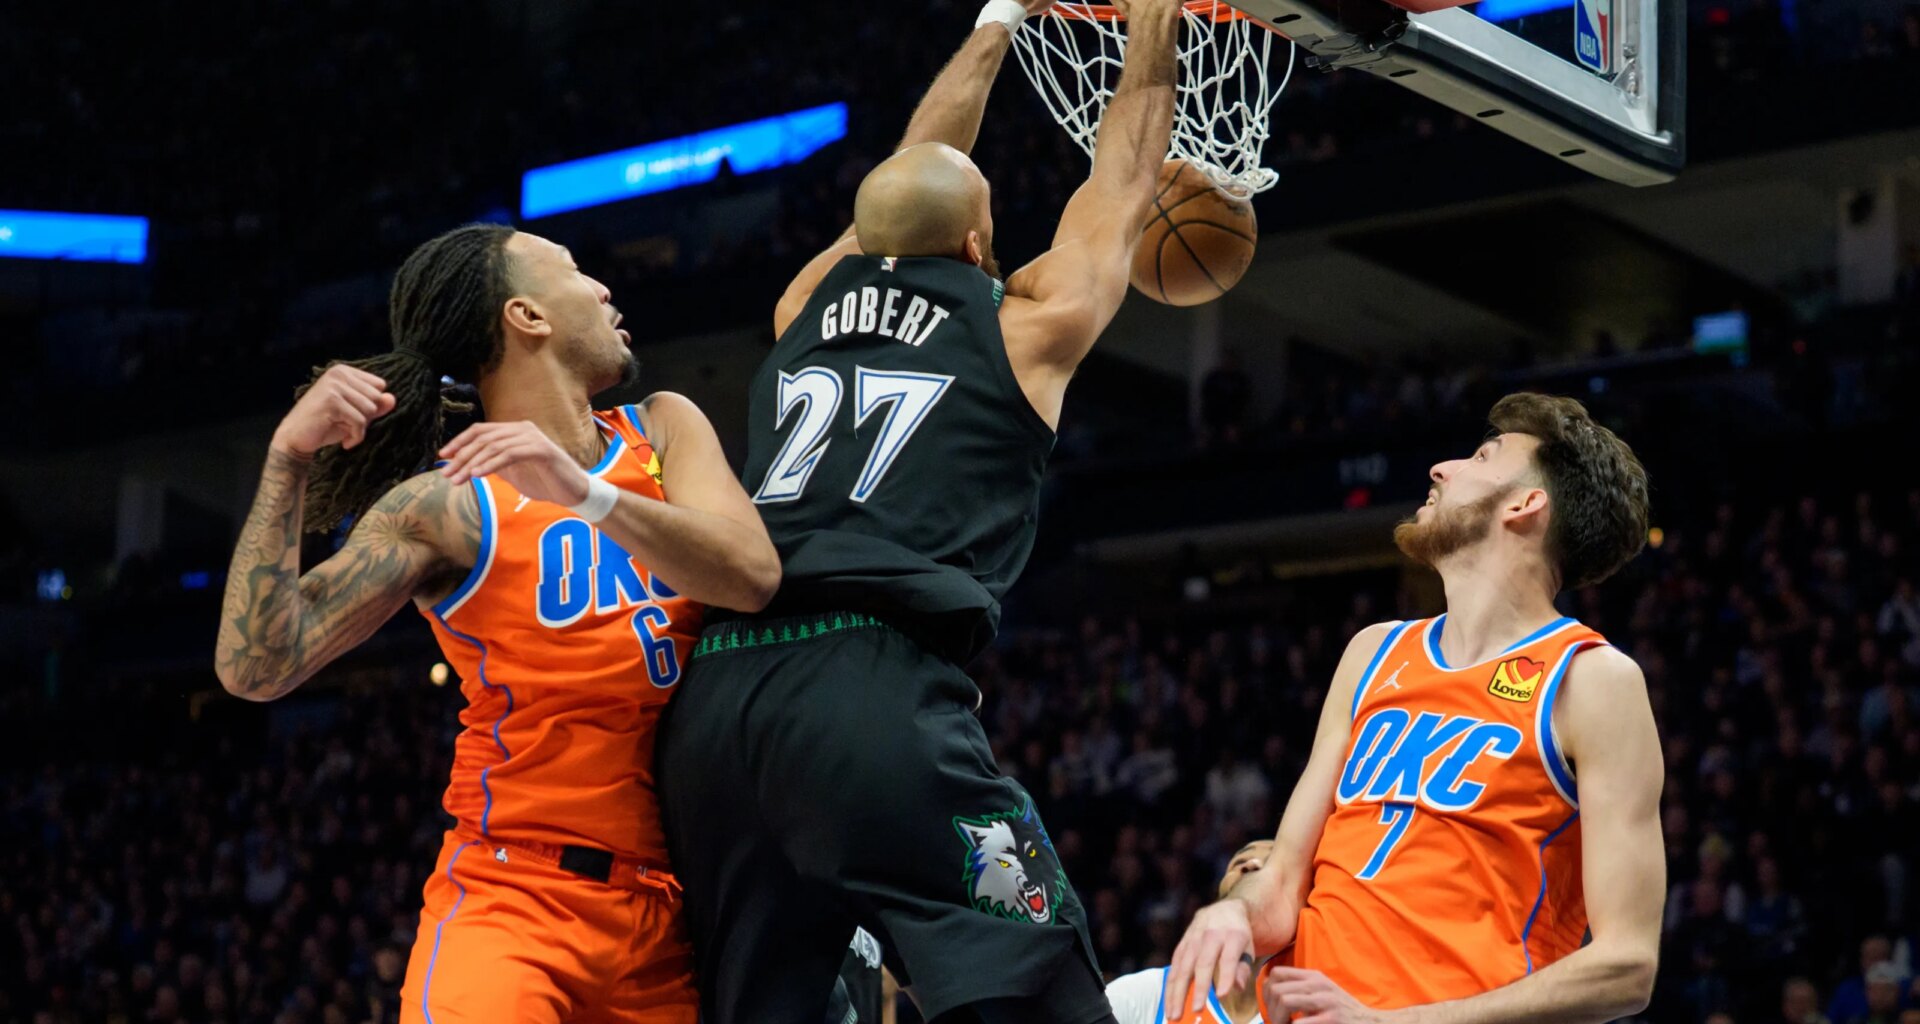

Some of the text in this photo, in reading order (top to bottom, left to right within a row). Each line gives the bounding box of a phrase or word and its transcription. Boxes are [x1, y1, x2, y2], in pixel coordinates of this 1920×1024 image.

[1580, 31, 1597, 60] NBA
[821, 286, 950, 347] GOBERT
[752, 364, 956, 504] 27
[536, 517, 682, 628] OK
[631, 603, 681, 688] 6
[1335, 707, 1523, 812] OKC
[1354, 801, 1416, 880] 7
